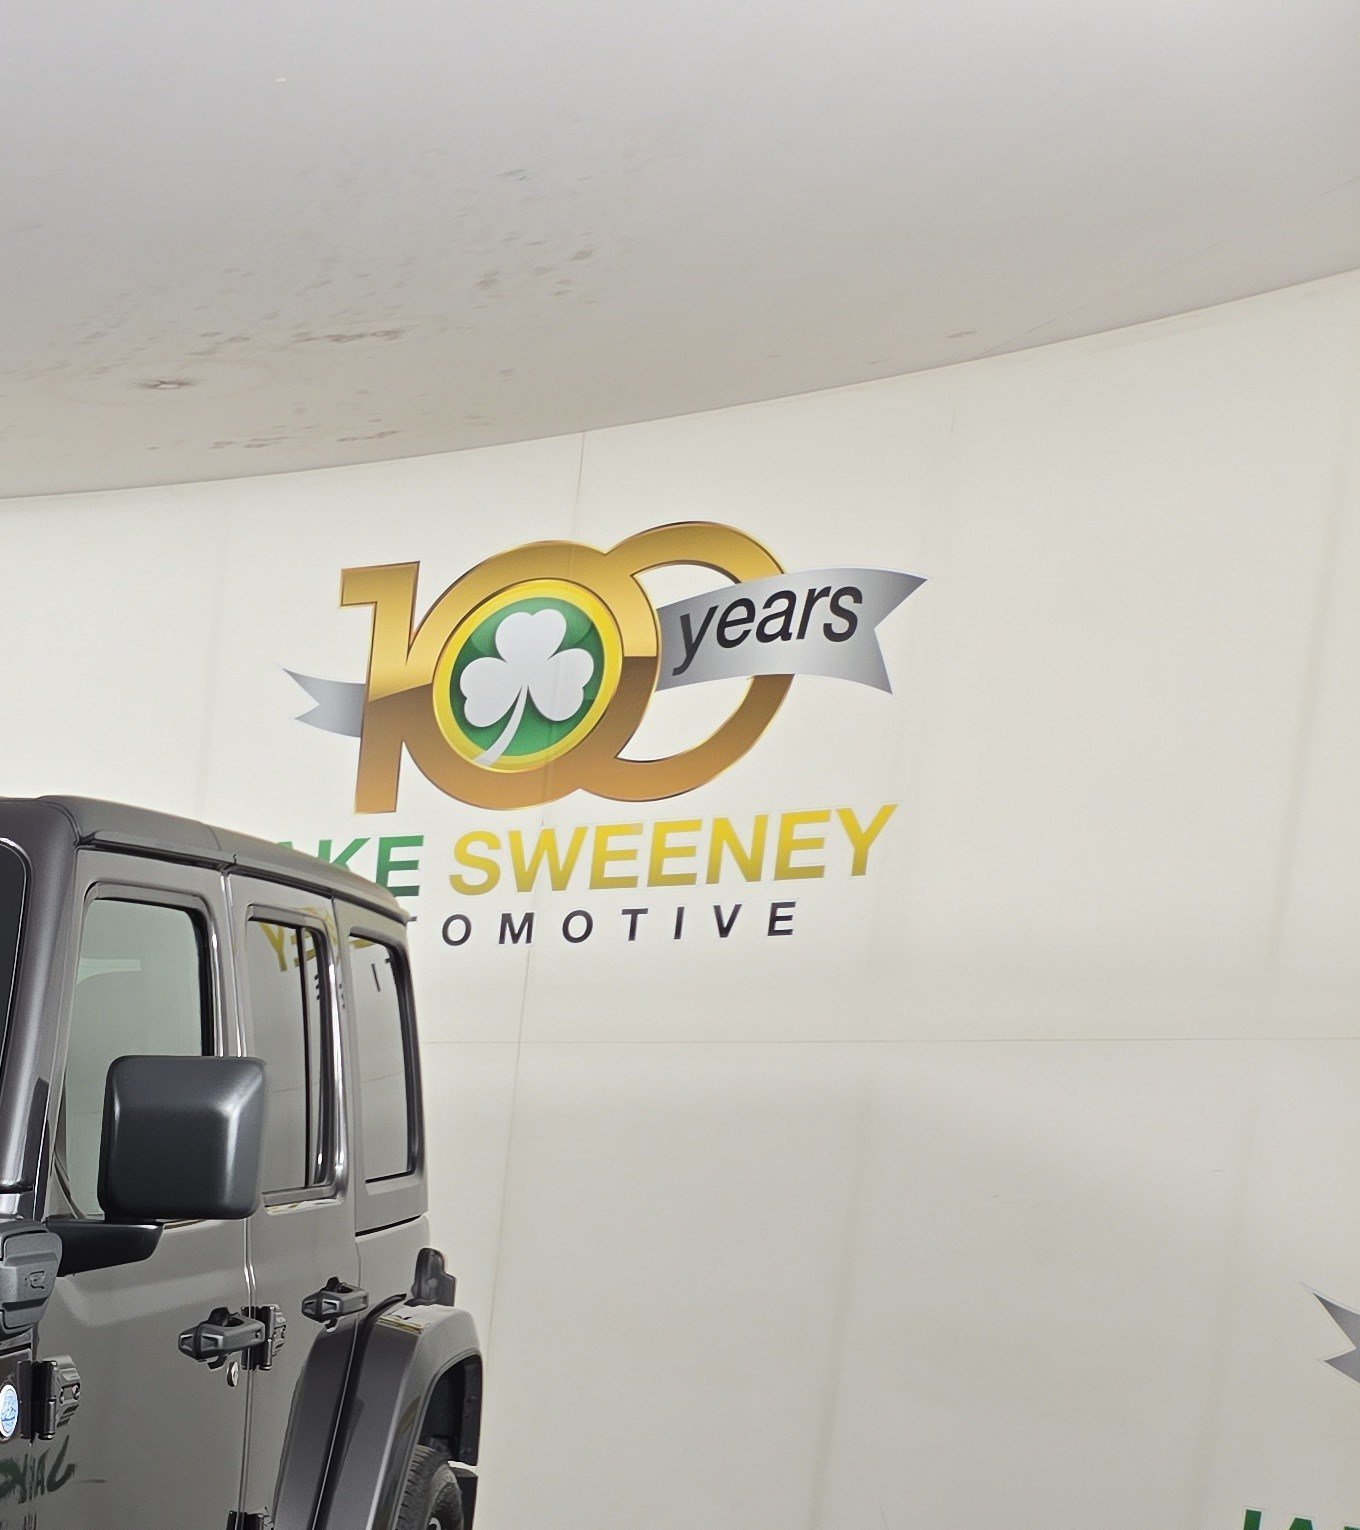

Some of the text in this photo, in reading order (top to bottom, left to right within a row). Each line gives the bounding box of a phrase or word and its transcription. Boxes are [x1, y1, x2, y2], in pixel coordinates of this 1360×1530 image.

[673, 586, 863, 676] years
[449, 804, 898, 896] SWEENEY
[408, 901, 797, 947] OMOTIVE
